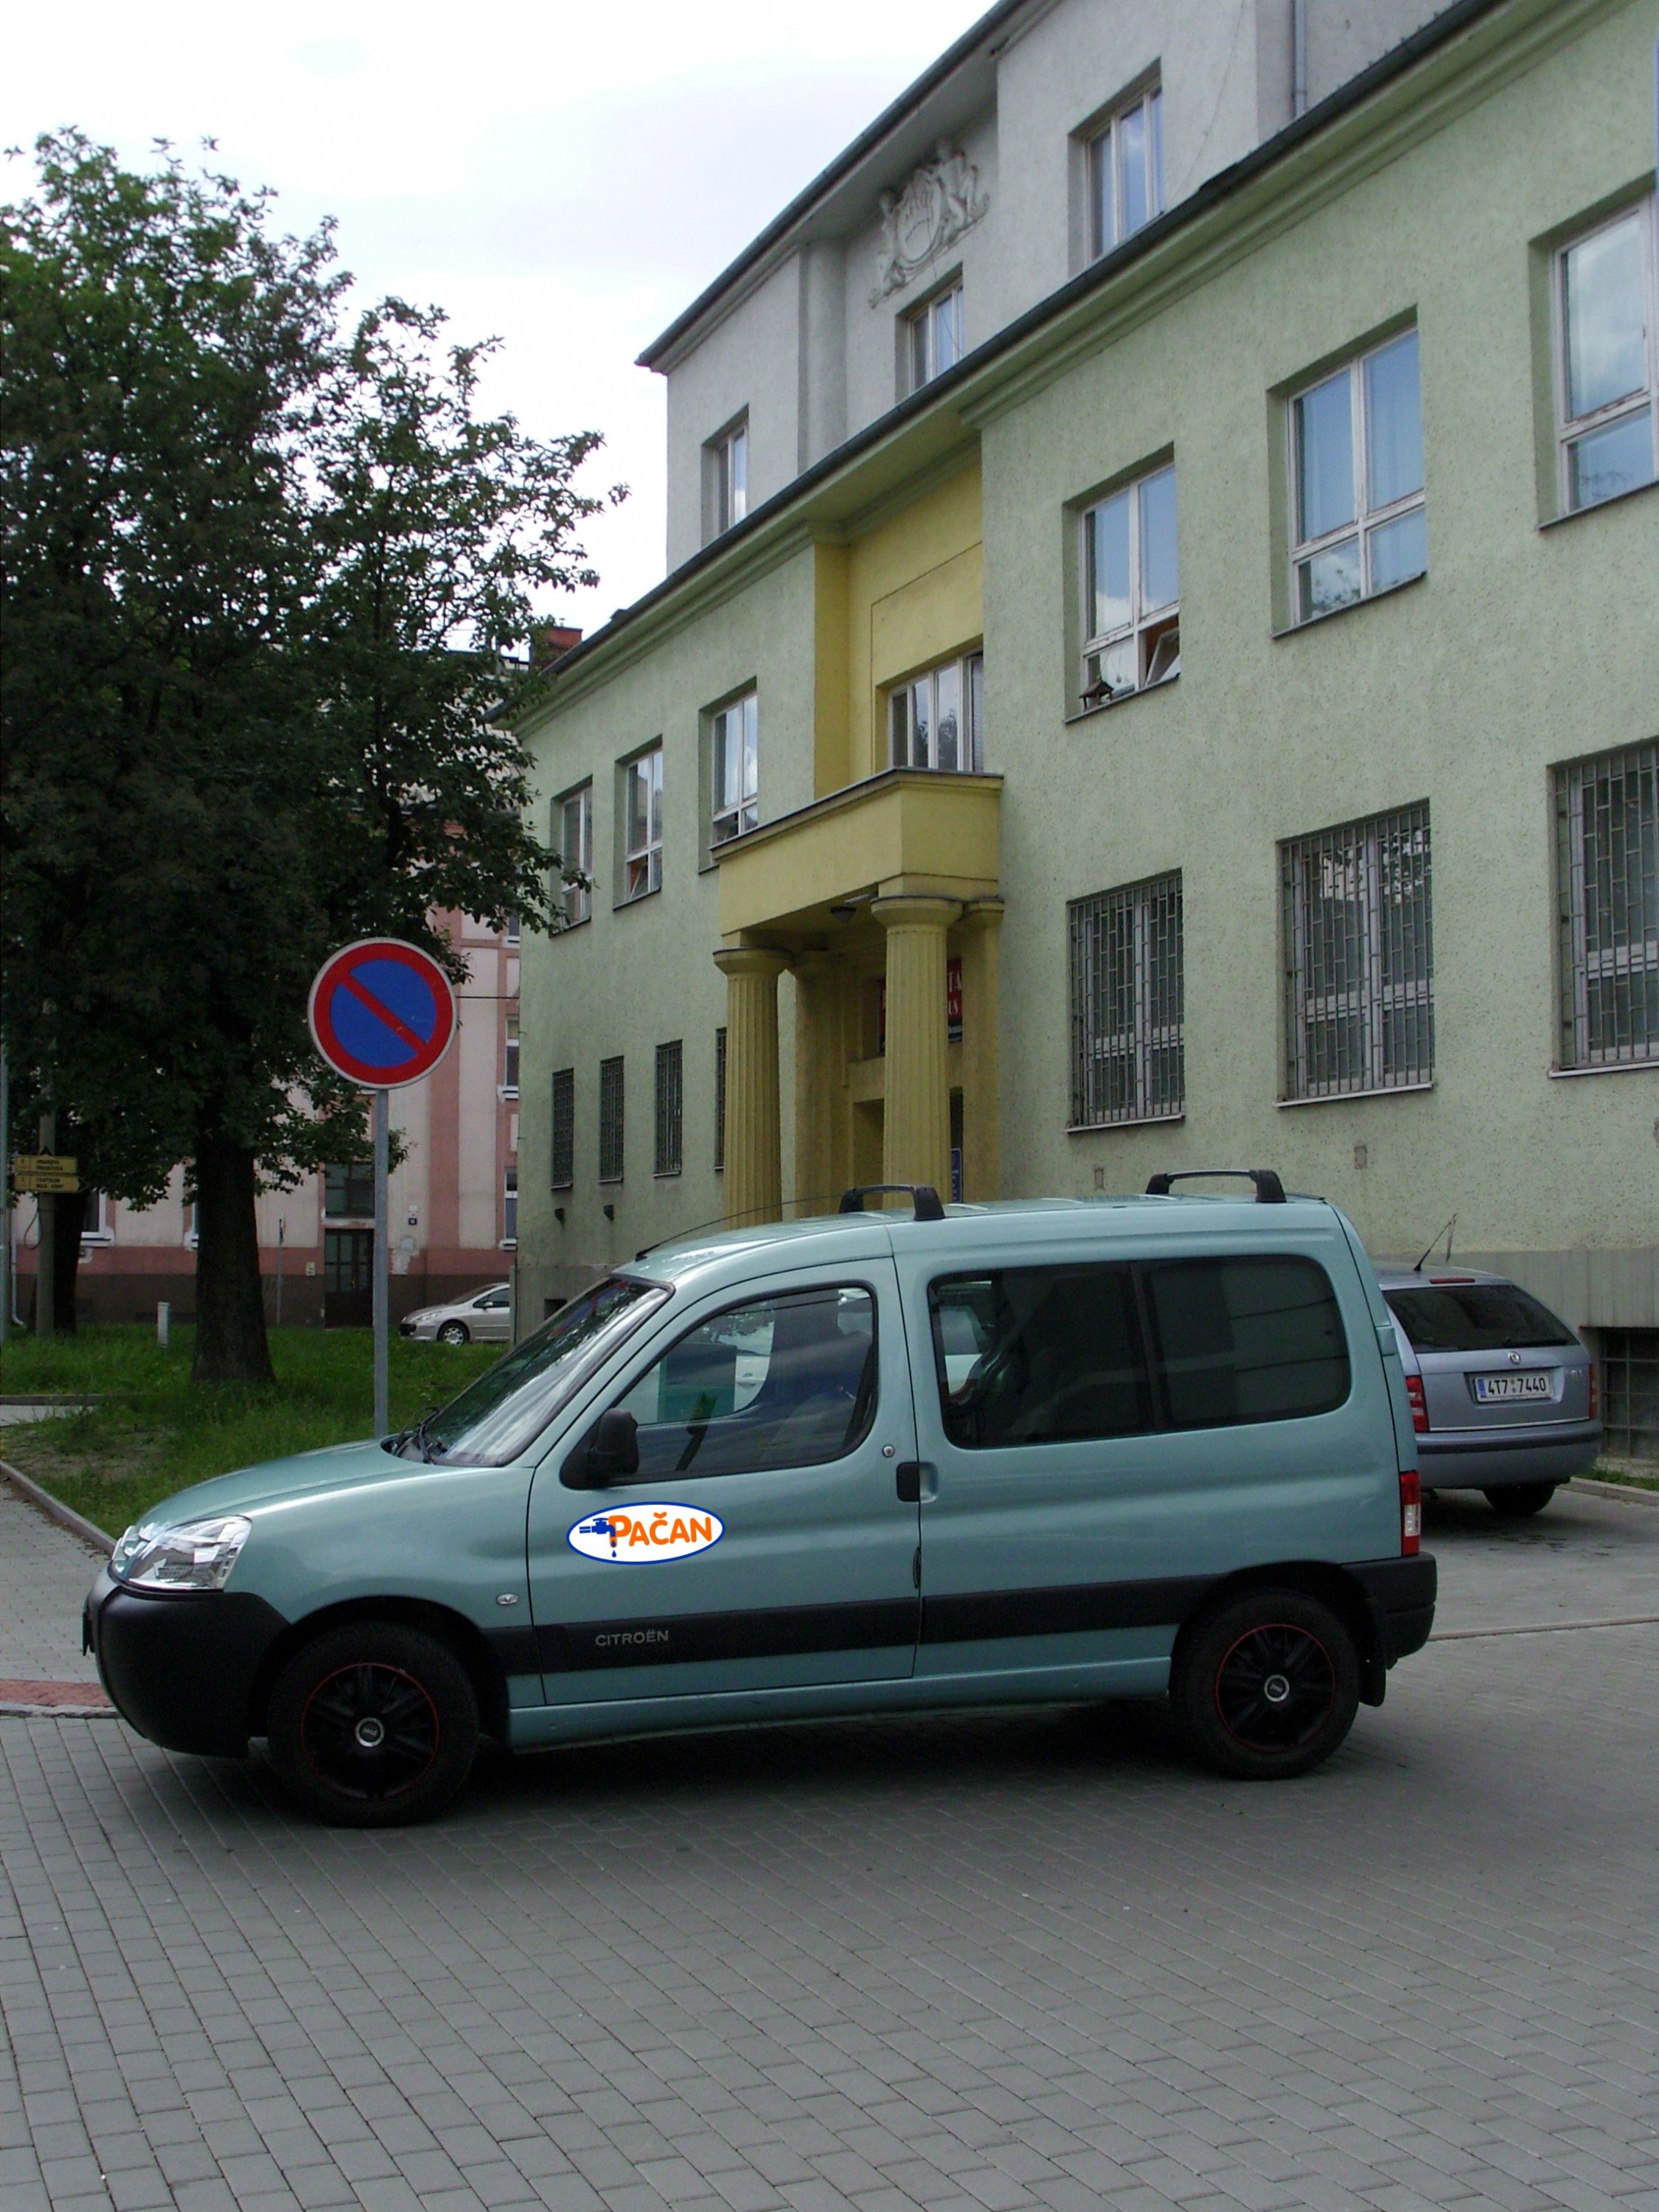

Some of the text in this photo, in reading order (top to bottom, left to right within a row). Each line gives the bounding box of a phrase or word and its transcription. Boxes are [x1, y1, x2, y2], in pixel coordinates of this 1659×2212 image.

[1488, 1377, 1547, 1395] 4T7 7440
[608, 1512, 712, 1548] PAČAN
[595, 1629, 669, 1646] CITROËN
